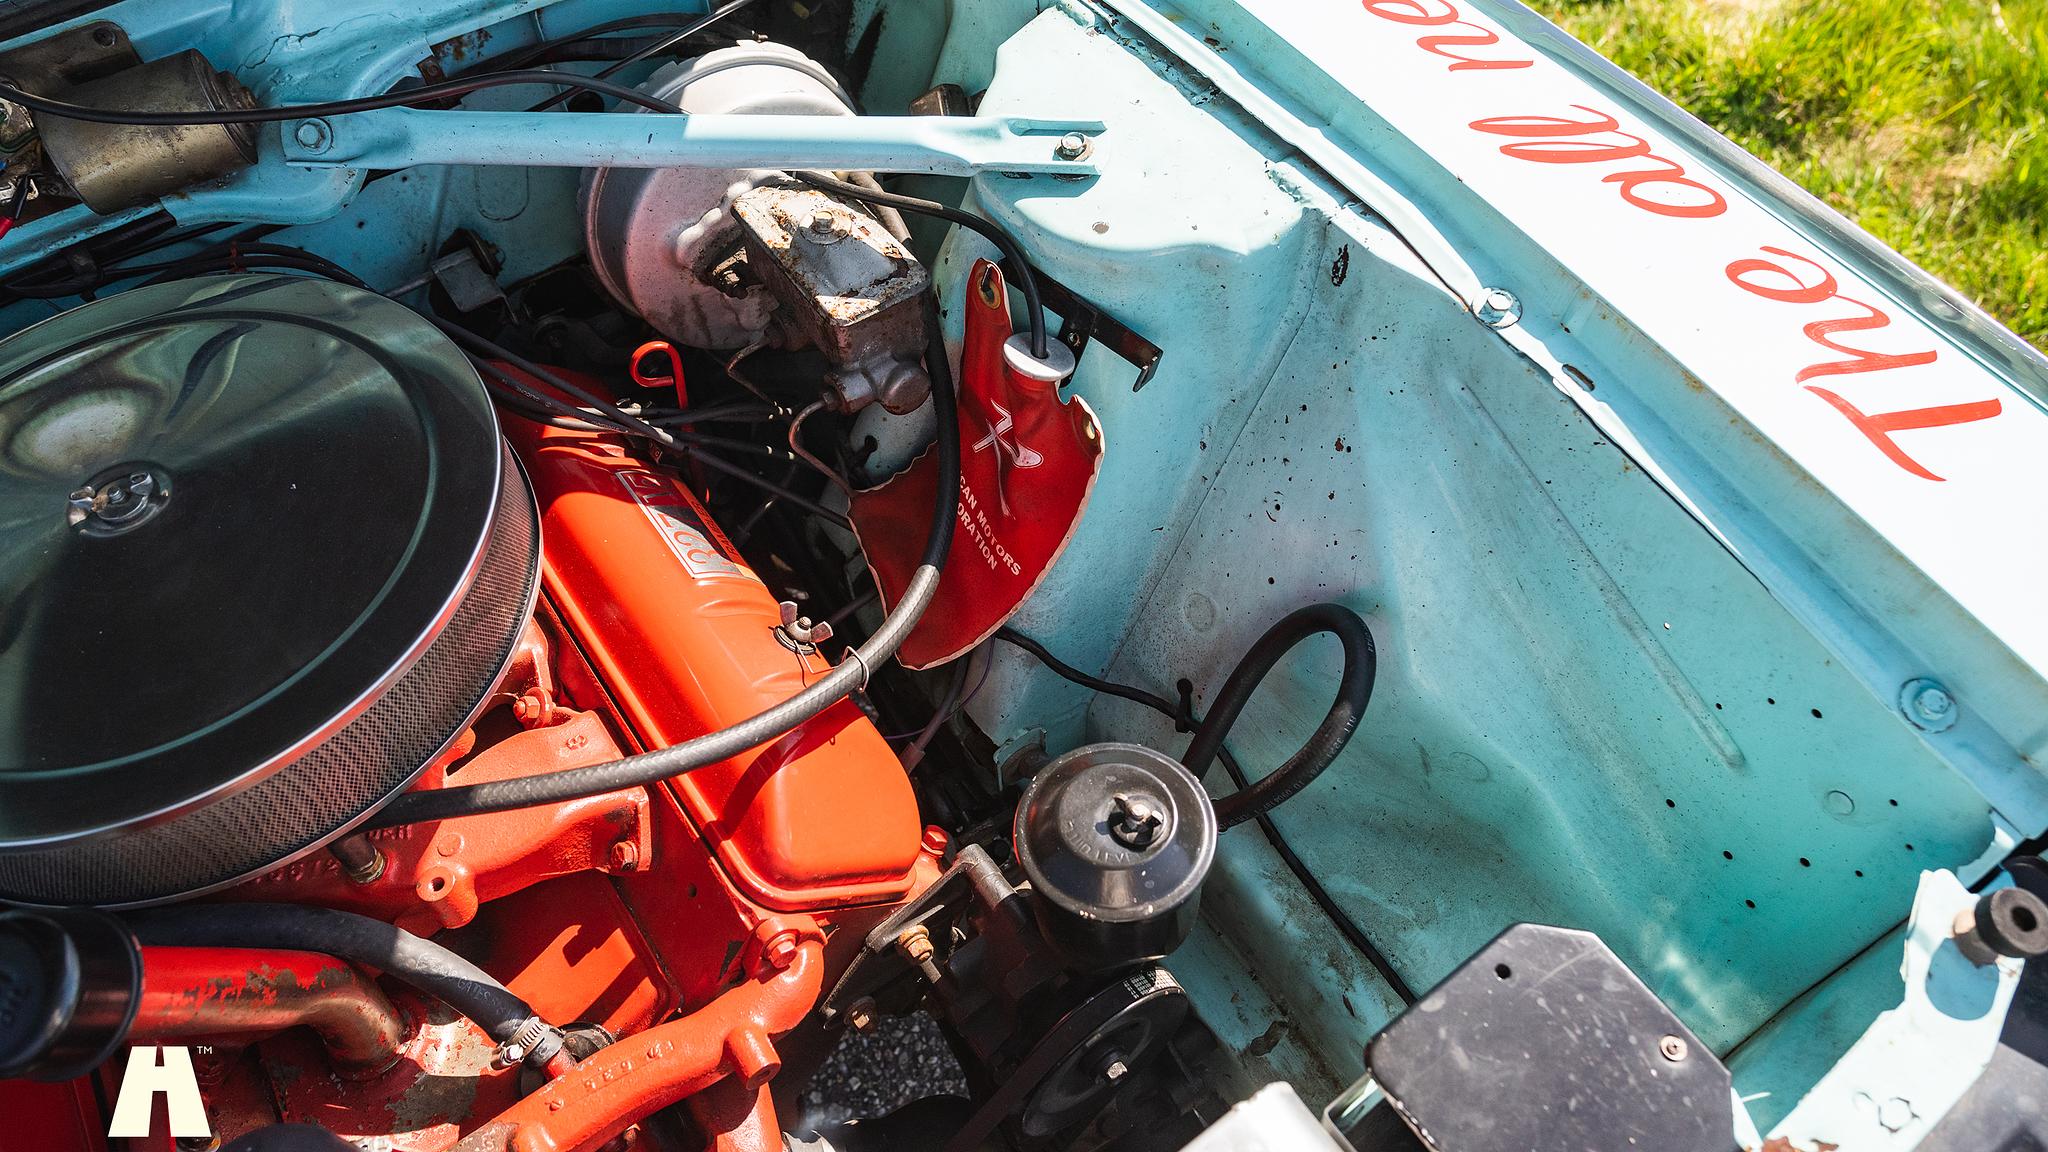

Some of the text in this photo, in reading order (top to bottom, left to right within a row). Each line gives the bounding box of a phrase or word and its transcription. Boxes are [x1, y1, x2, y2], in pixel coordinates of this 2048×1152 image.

[1362, 0, 2002, 482] The all ne
[957, 502, 998, 571] ORATION
[960, 475, 1021, 576] CAN MOTORS
